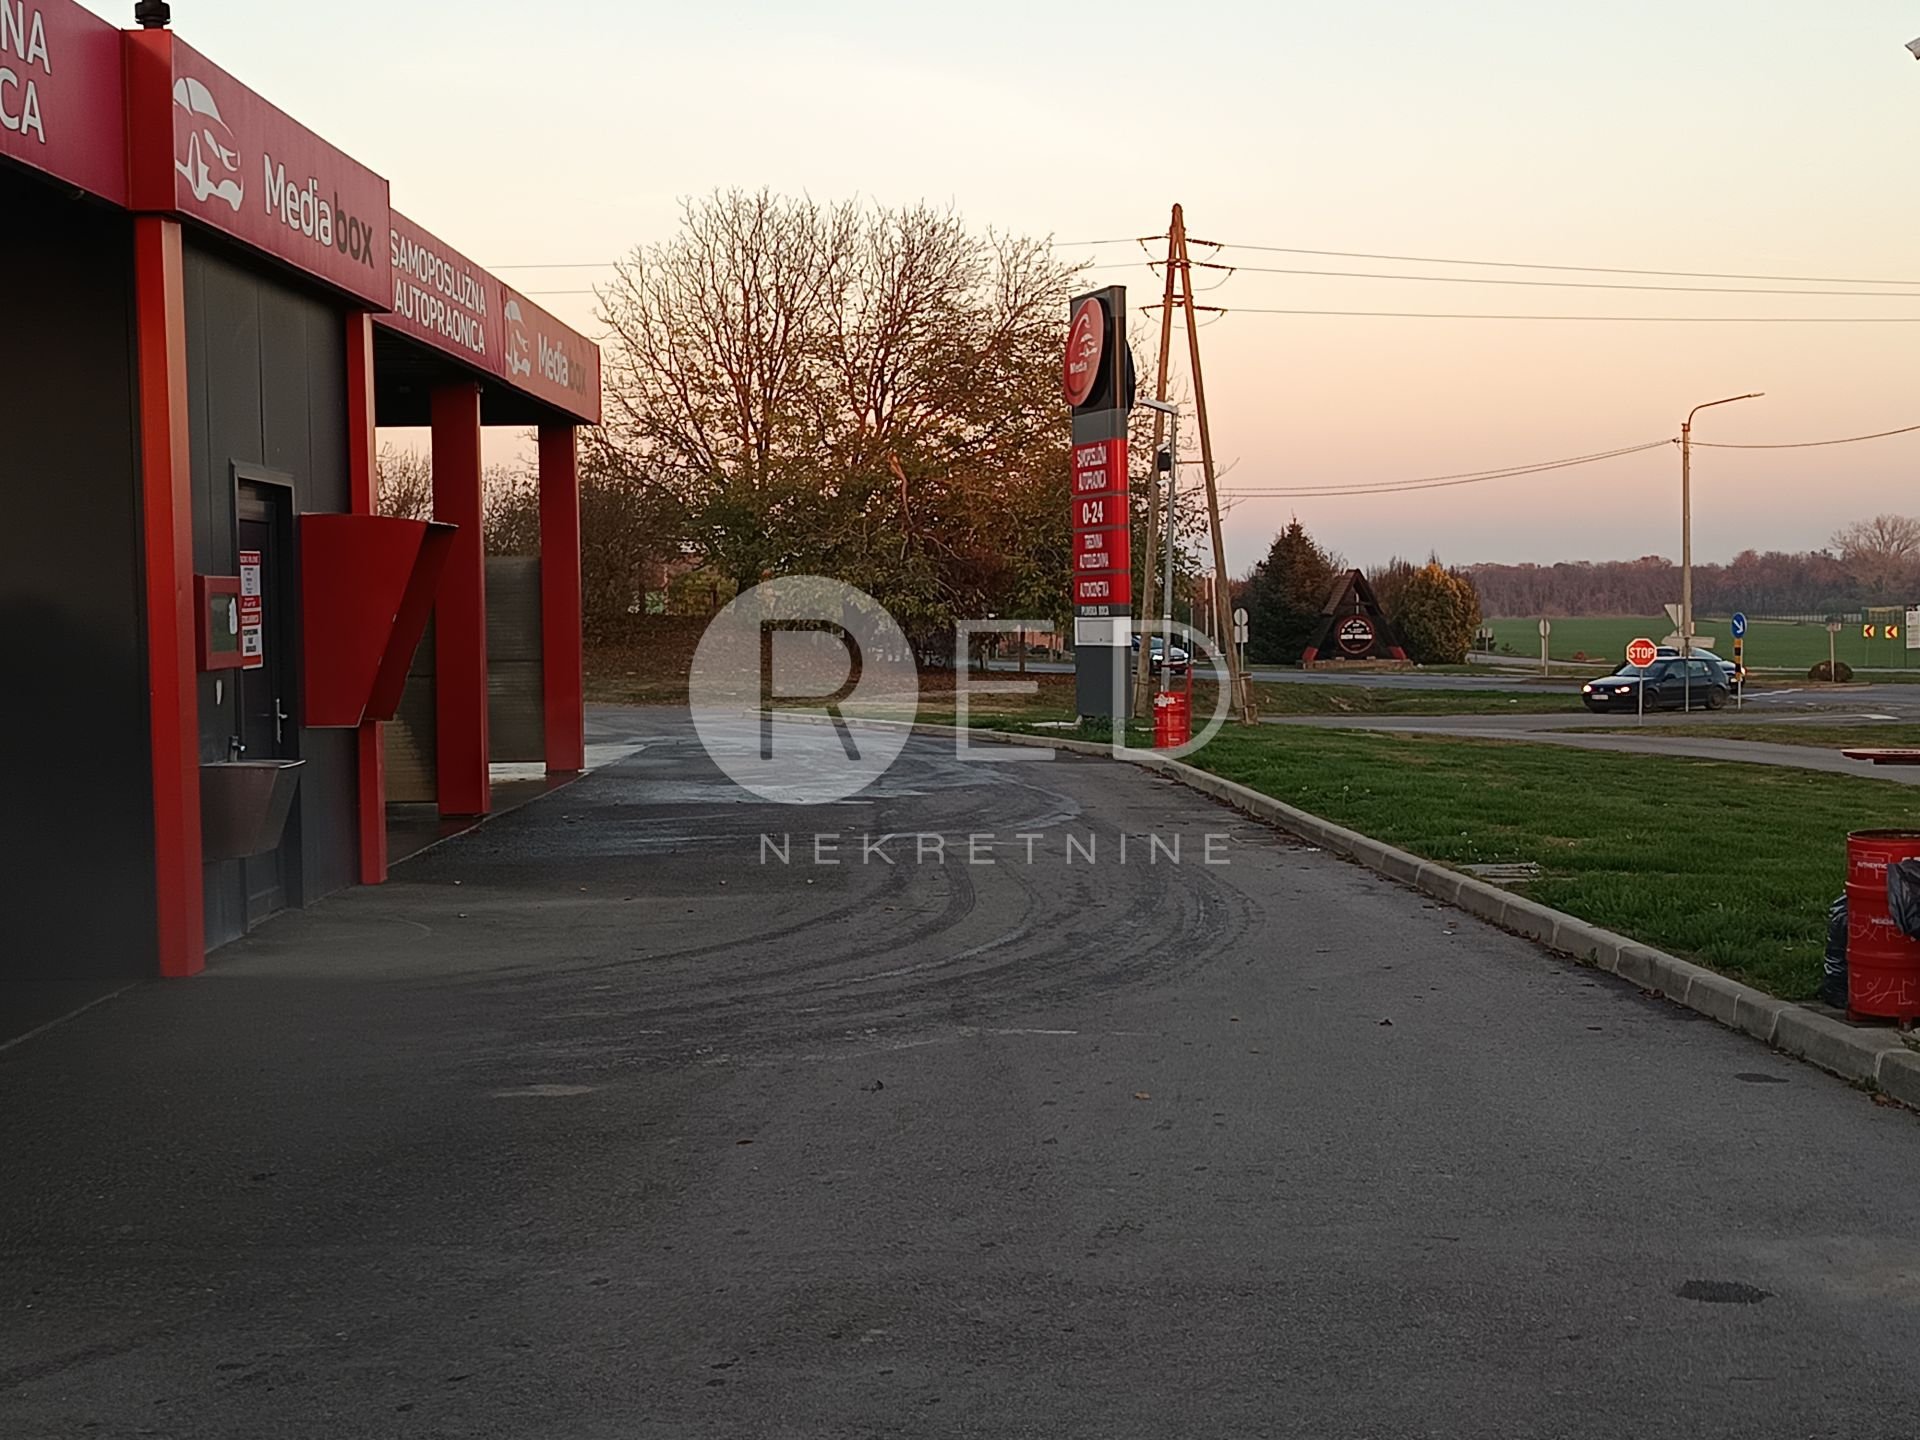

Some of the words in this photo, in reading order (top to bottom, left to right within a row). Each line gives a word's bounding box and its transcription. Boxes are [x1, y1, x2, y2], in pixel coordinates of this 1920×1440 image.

[263, 153, 374, 269] Mediabox
[390, 229, 487, 318] SAMOPOSLUŽNA
[394, 278, 486, 356] AUTOPRAONICA
[1082, 501, 1103, 525] 0-24
[1629, 647, 1654, 659] STOP
